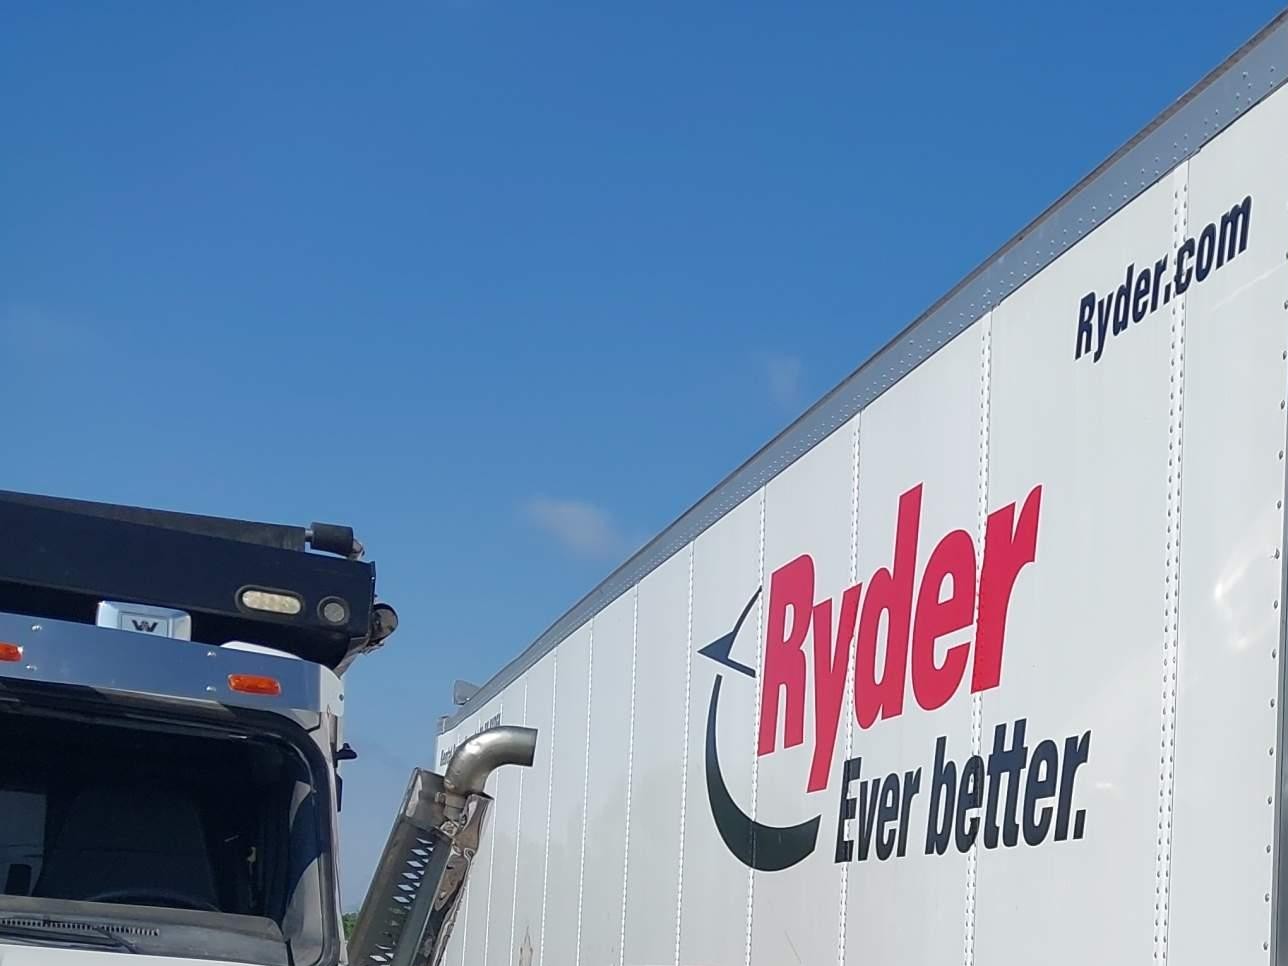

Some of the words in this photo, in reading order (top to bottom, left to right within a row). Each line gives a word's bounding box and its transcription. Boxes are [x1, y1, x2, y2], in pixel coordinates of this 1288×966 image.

[1075, 195, 1252, 361] Ryder.com
[757, 481, 1043, 794] Ryder
[834, 756, 923, 864] Ever
[924, 717, 1091, 856] better.
